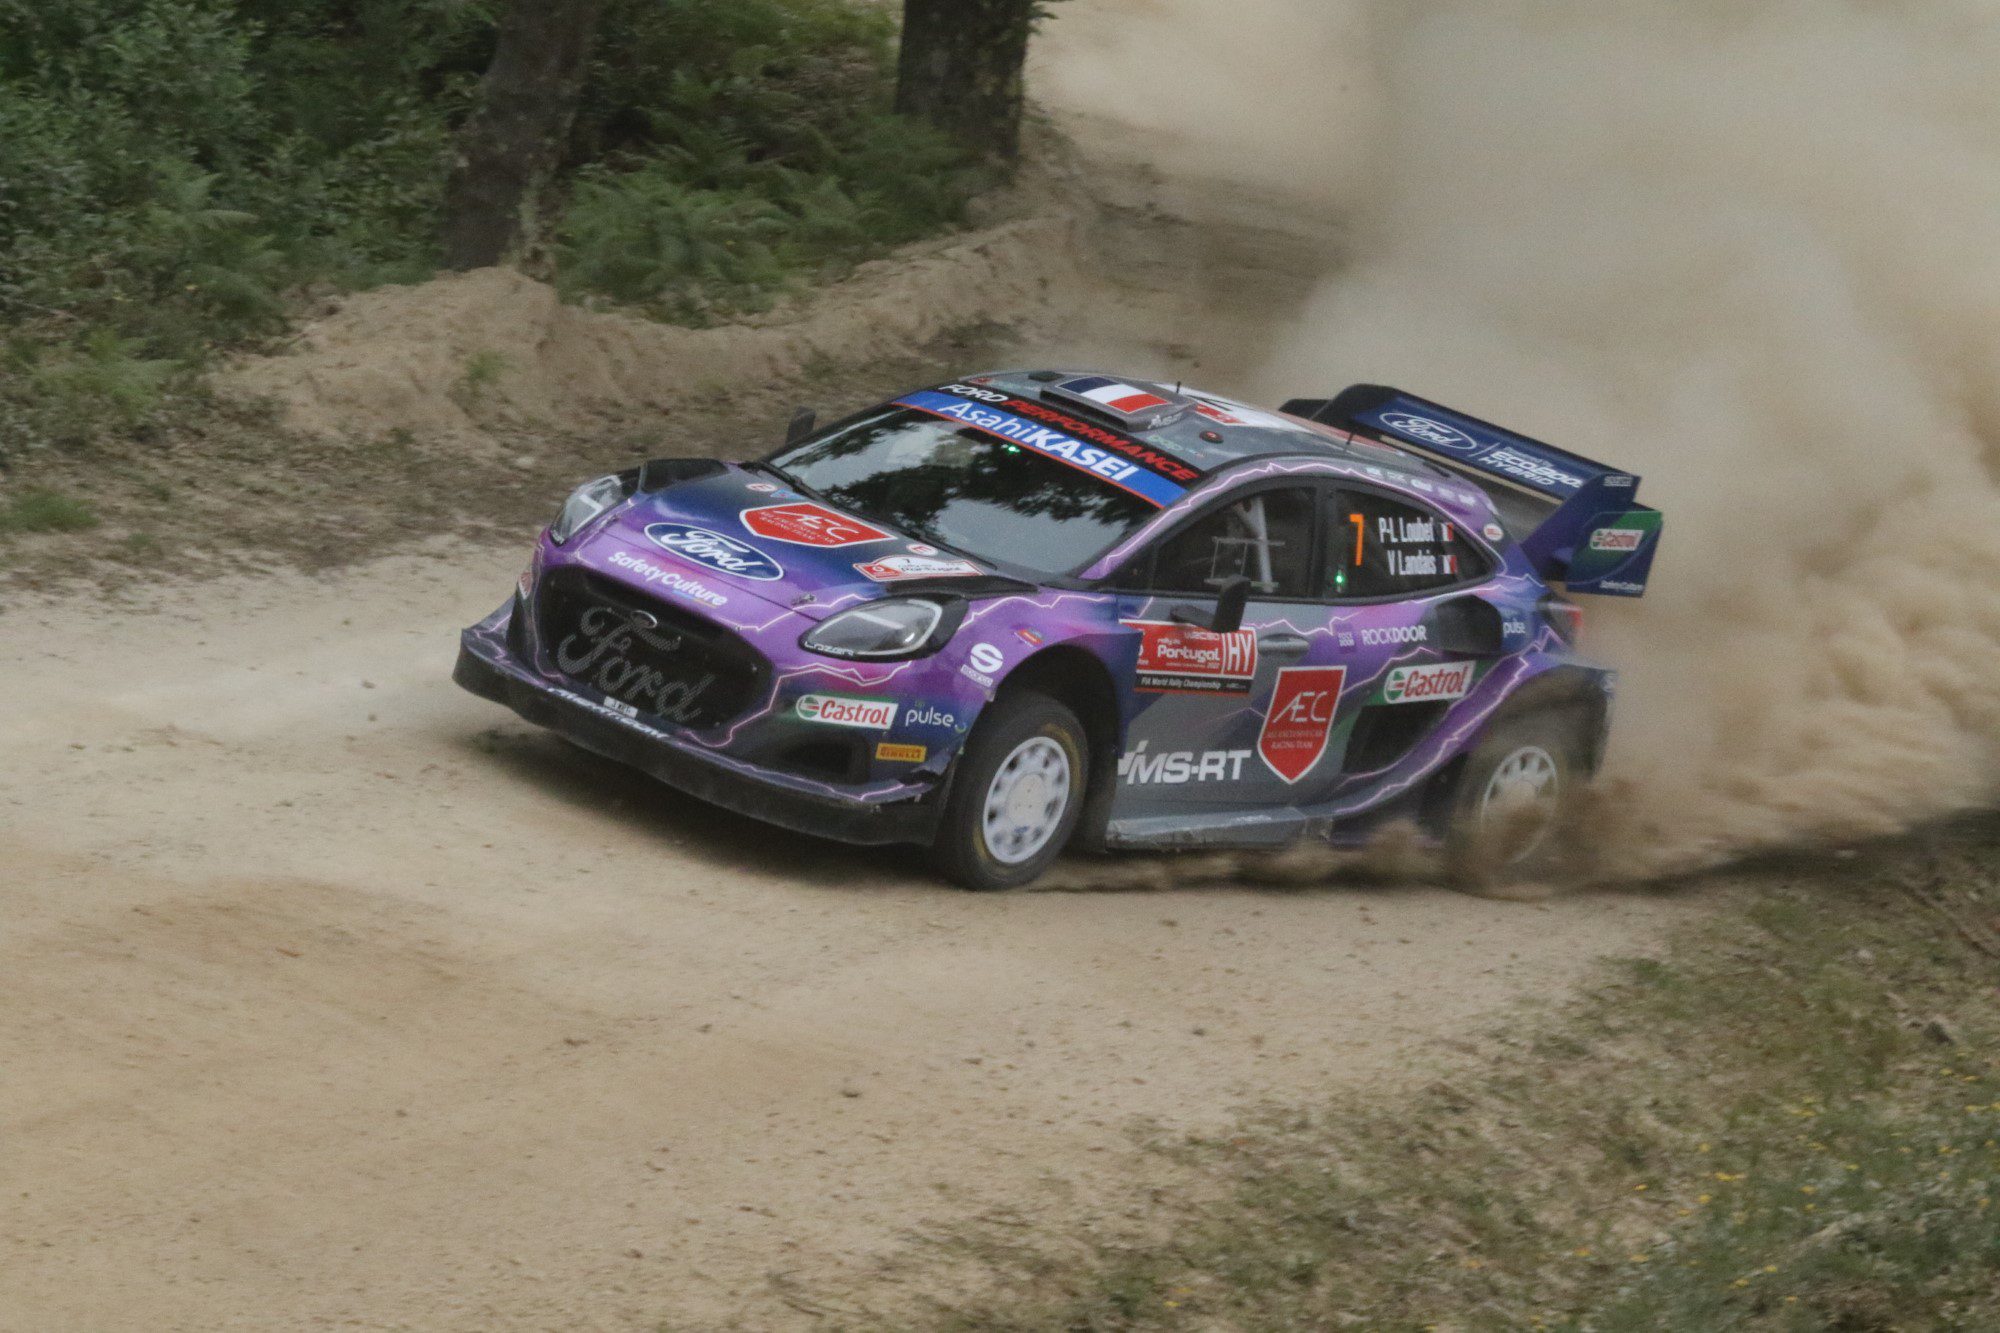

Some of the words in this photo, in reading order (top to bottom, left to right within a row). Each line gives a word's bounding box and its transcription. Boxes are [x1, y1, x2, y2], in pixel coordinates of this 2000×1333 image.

[938, 384, 1009, 402] FORD
[1001, 400, 1199, 482] PERFORMANCE
[1391, 417, 1462, 445] Ford
[1479, 457, 1556, 486] HYBRID
[660, 529, 764, 571] Ford
[1350, 513, 1364, 566] 7
[1387, 549, 1396, 575] V
[608, 551, 728, 606] SafetyCulture
[1361, 625, 1427, 646] ROCKDOOR
[557, 605, 716, 722] Ford
[1157, 644, 1220, 663] Portugal
[1227, 632, 1252, 672] HY
[1405, 666, 1468, 697] Castrol
[820, 700, 890, 726] Castrol
[905, 707, 955, 728] pulse
